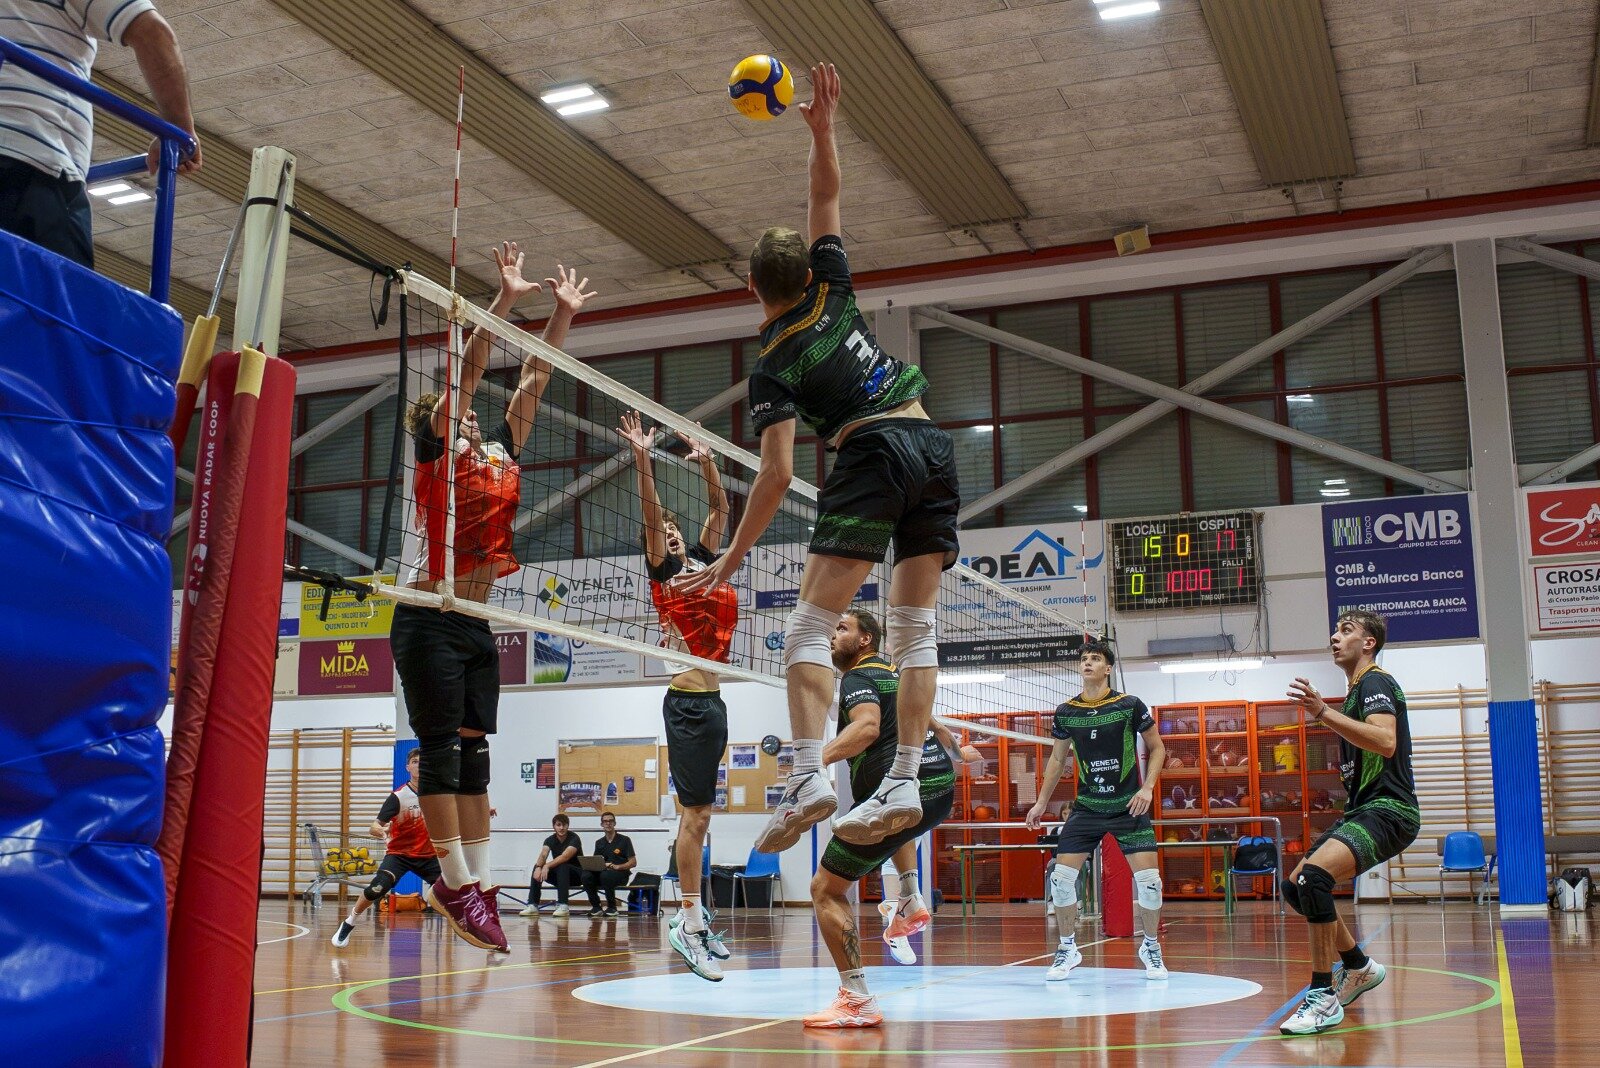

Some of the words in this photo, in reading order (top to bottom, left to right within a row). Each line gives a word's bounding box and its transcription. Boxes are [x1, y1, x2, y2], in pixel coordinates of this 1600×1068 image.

[210, 400, 219, 437] COOP
[204, 442, 215, 486] RADAR
[200, 490, 211, 539] NUOVA
[1126, 523, 1166, 537] LOCALI
[1199, 517, 1240, 531] OSPITI
[1364, 515, 1373, 545] Banco
[1374, 509, 1461, 543] CMB
[1144, 535, 1161, 557] 15
[1177, 534, 1189, 556] 0
[1216, 530, 1235, 552] 17
[1399, 541, 1424, 549] GRUPPO
[1222, 559, 1244, 567] FALLI
[1335, 563, 1364, 575] CMB
[1368, 562, 1376, 572] è
[1125, 566, 1147, 574] FALLI
[571, 576, 634, 591] VENETA
[1131, 573, 1144, 595] 0
[1336, 573, 1419, 587] CentroMarca
[1422, 570, 1464, 581] Banca
[1020, 584, 1051, 593] BASHKIM
[1547, 585, 1600, 596] AUTOTRAS
[571, 591, 634, 604] COPERTURE
[1043, 595, 1097, 606] CARTONGESSI
[1358, 600, 1430, 612] CENTROMARCA
[1432, 597, 1467, 607] BANCA
[1549, 607, 1589, 615] Trasporto
[325, 622, 350, 631] QUINTO
[320, 654, 369, 673] MIDA
[1090, 729, 1097, 739] 6
[1090, 758, 1119, 767] VENETA
